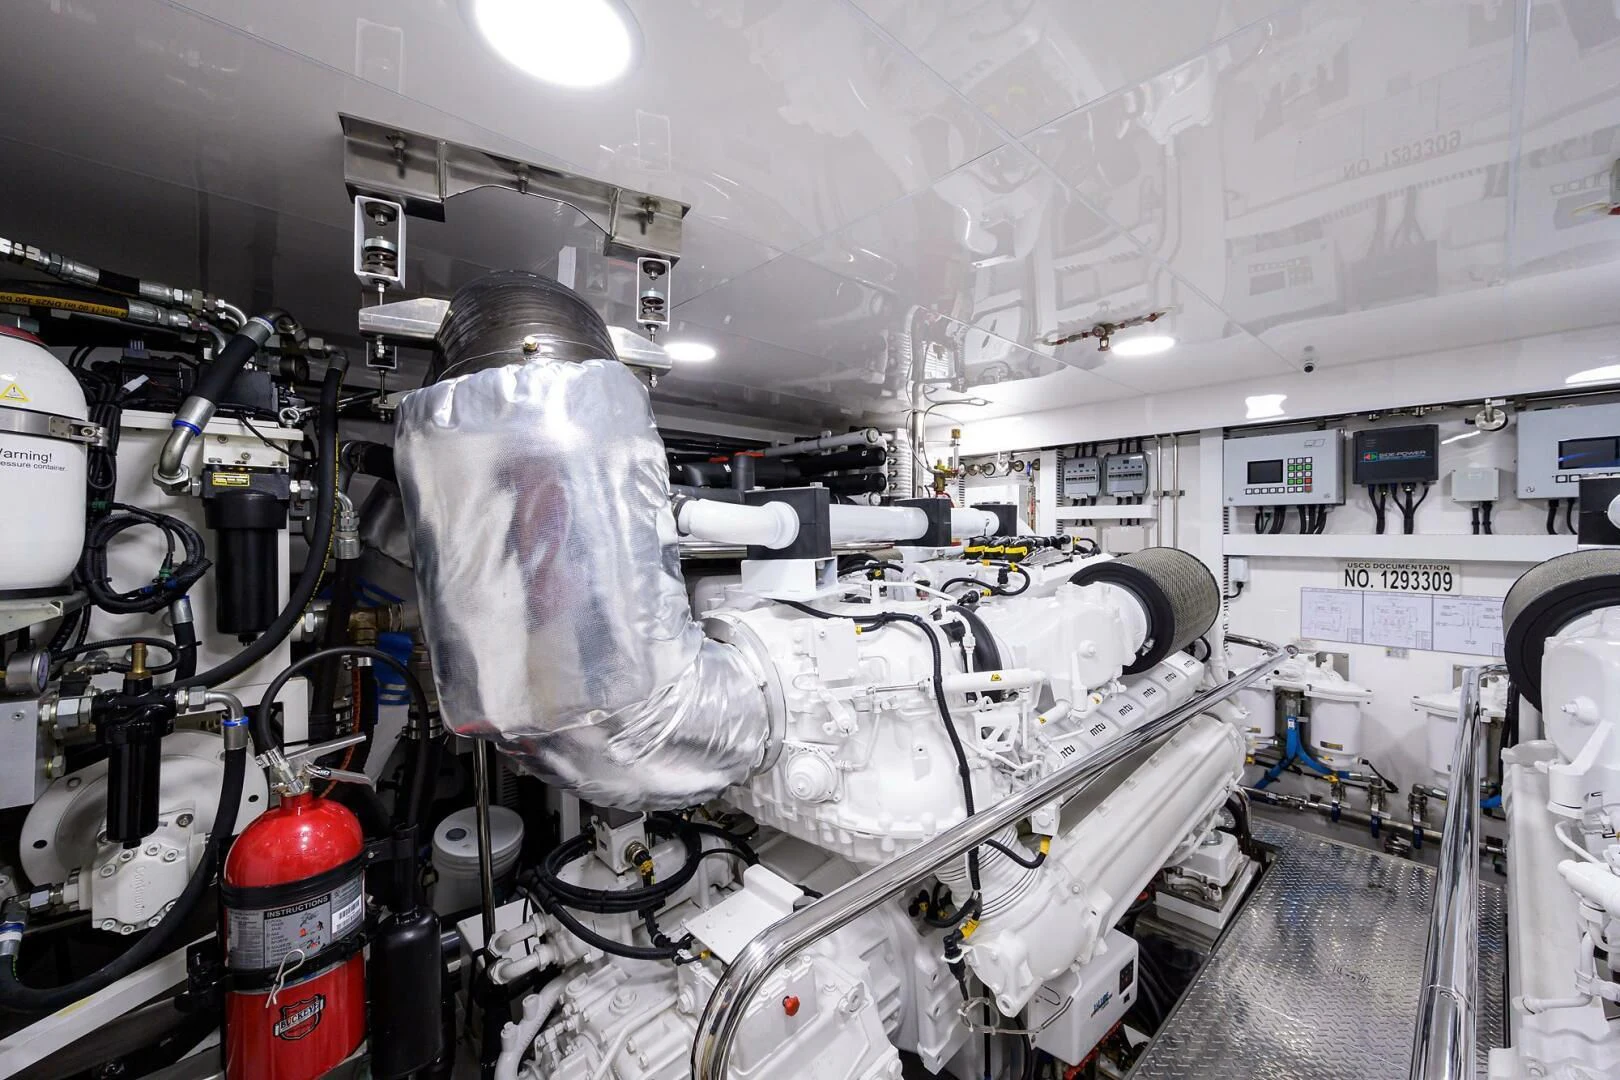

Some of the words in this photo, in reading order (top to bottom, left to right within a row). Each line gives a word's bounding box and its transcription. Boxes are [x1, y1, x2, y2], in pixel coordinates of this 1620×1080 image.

[0, 448, 52, 464] arning!
[33, 463, 66, 471] container
[1345, 569, 1373, 588] NO.
[1381, 570, 1453, 592] 1293309
[1165, 672, 1177, 683] mtu
[1142, 686, 1157, 698] mtu
[1118, 703, 1134, 717] mtu
[1089, 722, 1107, 737] mtu
[266, 894, 328, 918] INSTRUCTIONS
[281, 1000, 320, 1029] BUCKEYE
